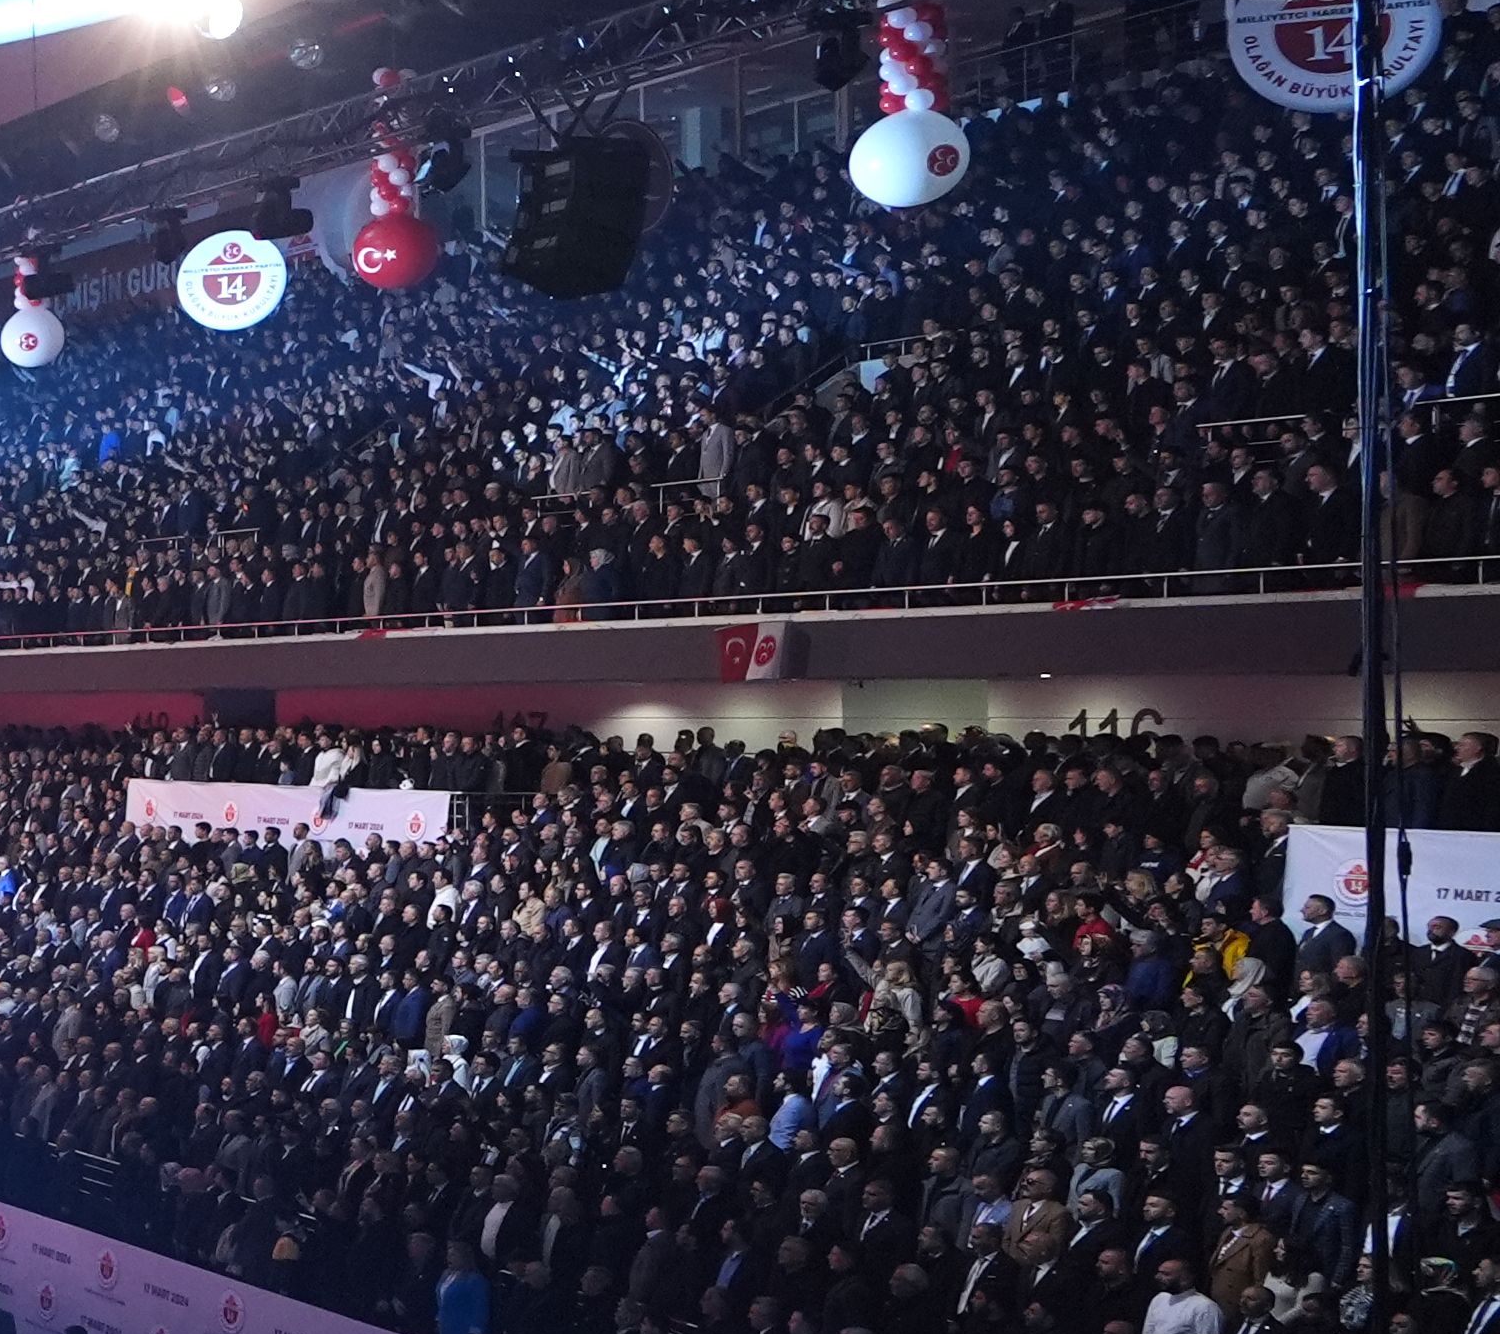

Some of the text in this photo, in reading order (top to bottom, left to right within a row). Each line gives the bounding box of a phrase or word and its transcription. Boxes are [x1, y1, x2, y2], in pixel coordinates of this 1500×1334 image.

[1312, 7, 1353, 17] HAREK
[1243, 19, 1426, 99] OLAĞAN BÜYÜK RULTAYI
[1436, 887, 1450, 900] 17
[1453, 889, 1491, 903] MART
